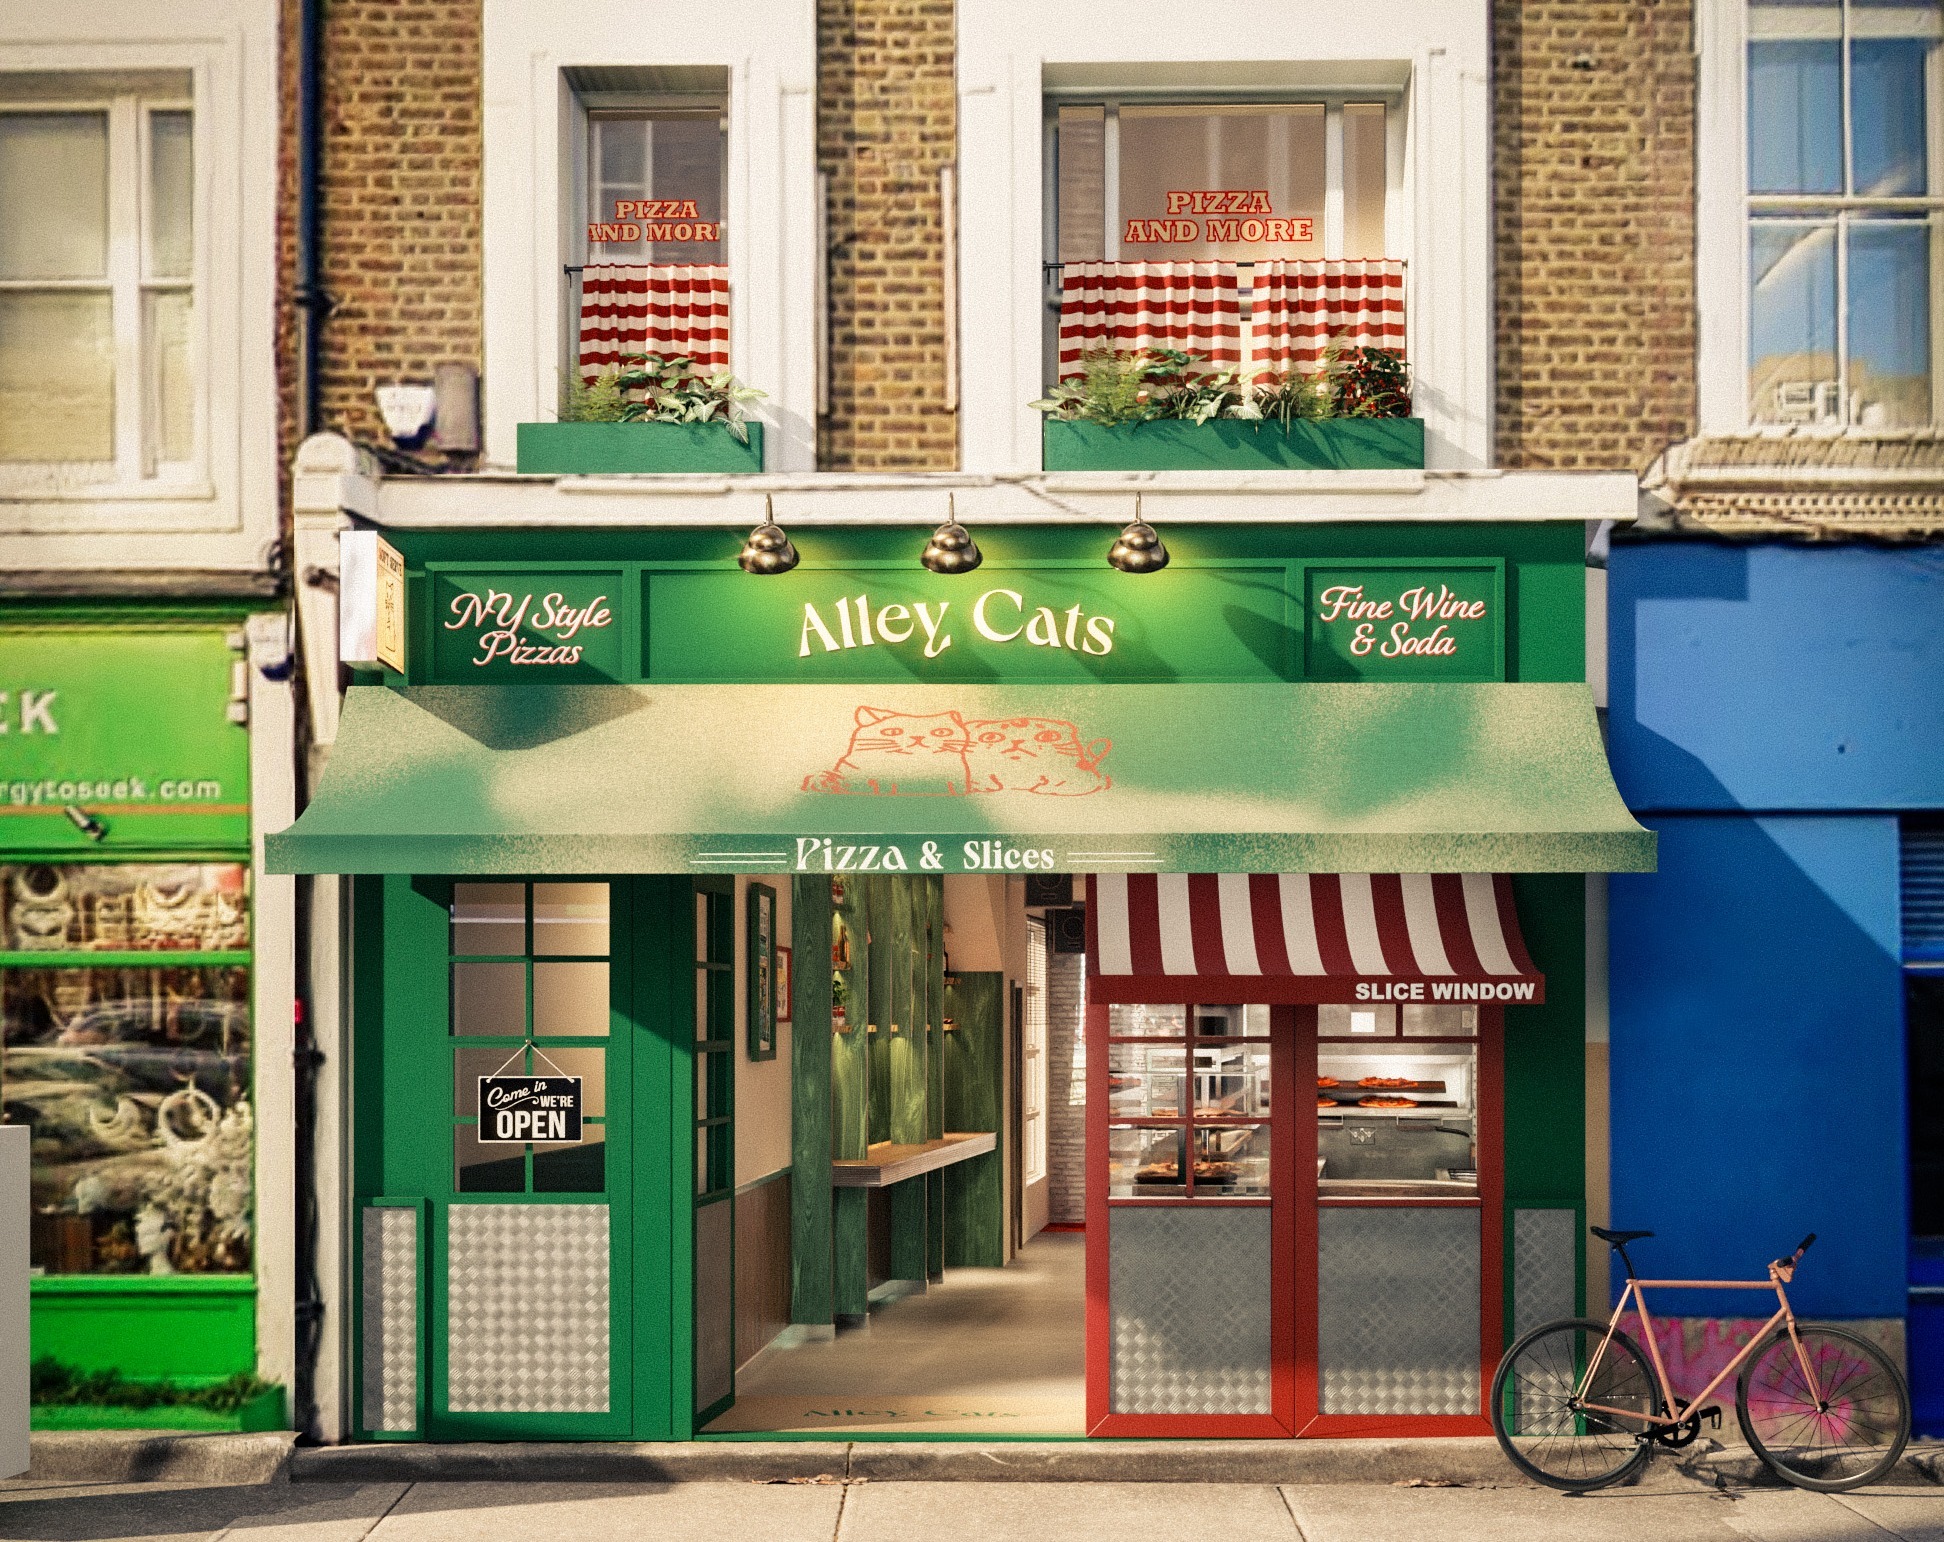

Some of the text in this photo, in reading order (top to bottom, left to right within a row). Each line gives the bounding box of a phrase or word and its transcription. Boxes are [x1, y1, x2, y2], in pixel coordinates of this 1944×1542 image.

[616, 199, 699, 220] PIZZA
[1167, 190, 1272, 214] PIZZA
[588, 223, 641, 242] AND
[1124, 218, 1313, 243] AND MORE
[444, 588, 613, 640] NY Style
[1320, 584, 1487, 622] Fine Wine
[799, 589, 1116, 658] Alley Cats
[472, 630, 585, 667] Pizzas
[1350, 621, 1458, 659] & Soda
[795, 837, 1055, 871] Pizza & Slices
[1355, 983, 1536, 1001] SLICE WINDOW
[487, 1080, 548, 1108] Come in
[540, 1095, 574, 1108] WE'RE
[496, 1110, 566, 1139] OPEN
